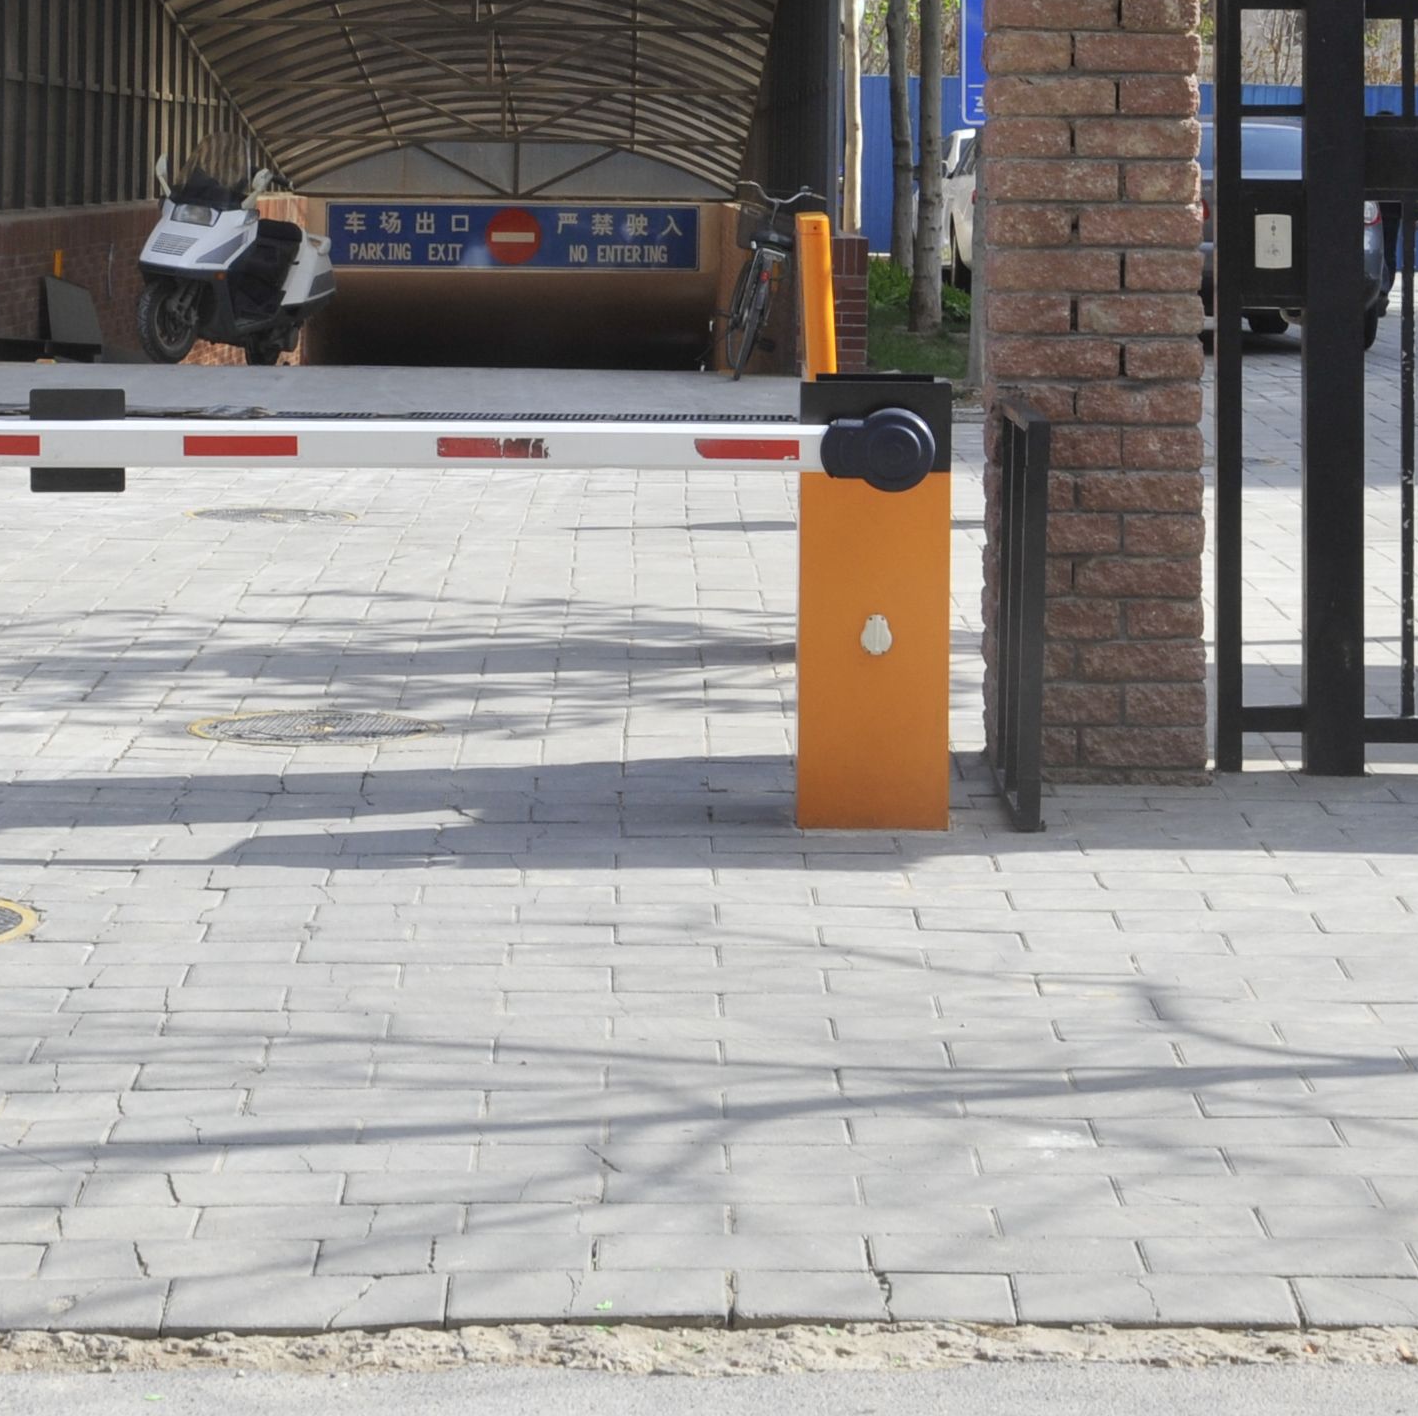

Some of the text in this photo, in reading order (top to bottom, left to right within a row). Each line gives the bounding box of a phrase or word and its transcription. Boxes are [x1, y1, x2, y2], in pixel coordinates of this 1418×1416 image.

[344, 211, 469, 234] 车场出口
[557, 213, 683, 236] 严禁驶入
[349, 243, 463, 261] PARKING EXIT
[569, 245, 668, 263] NO ENTERING
